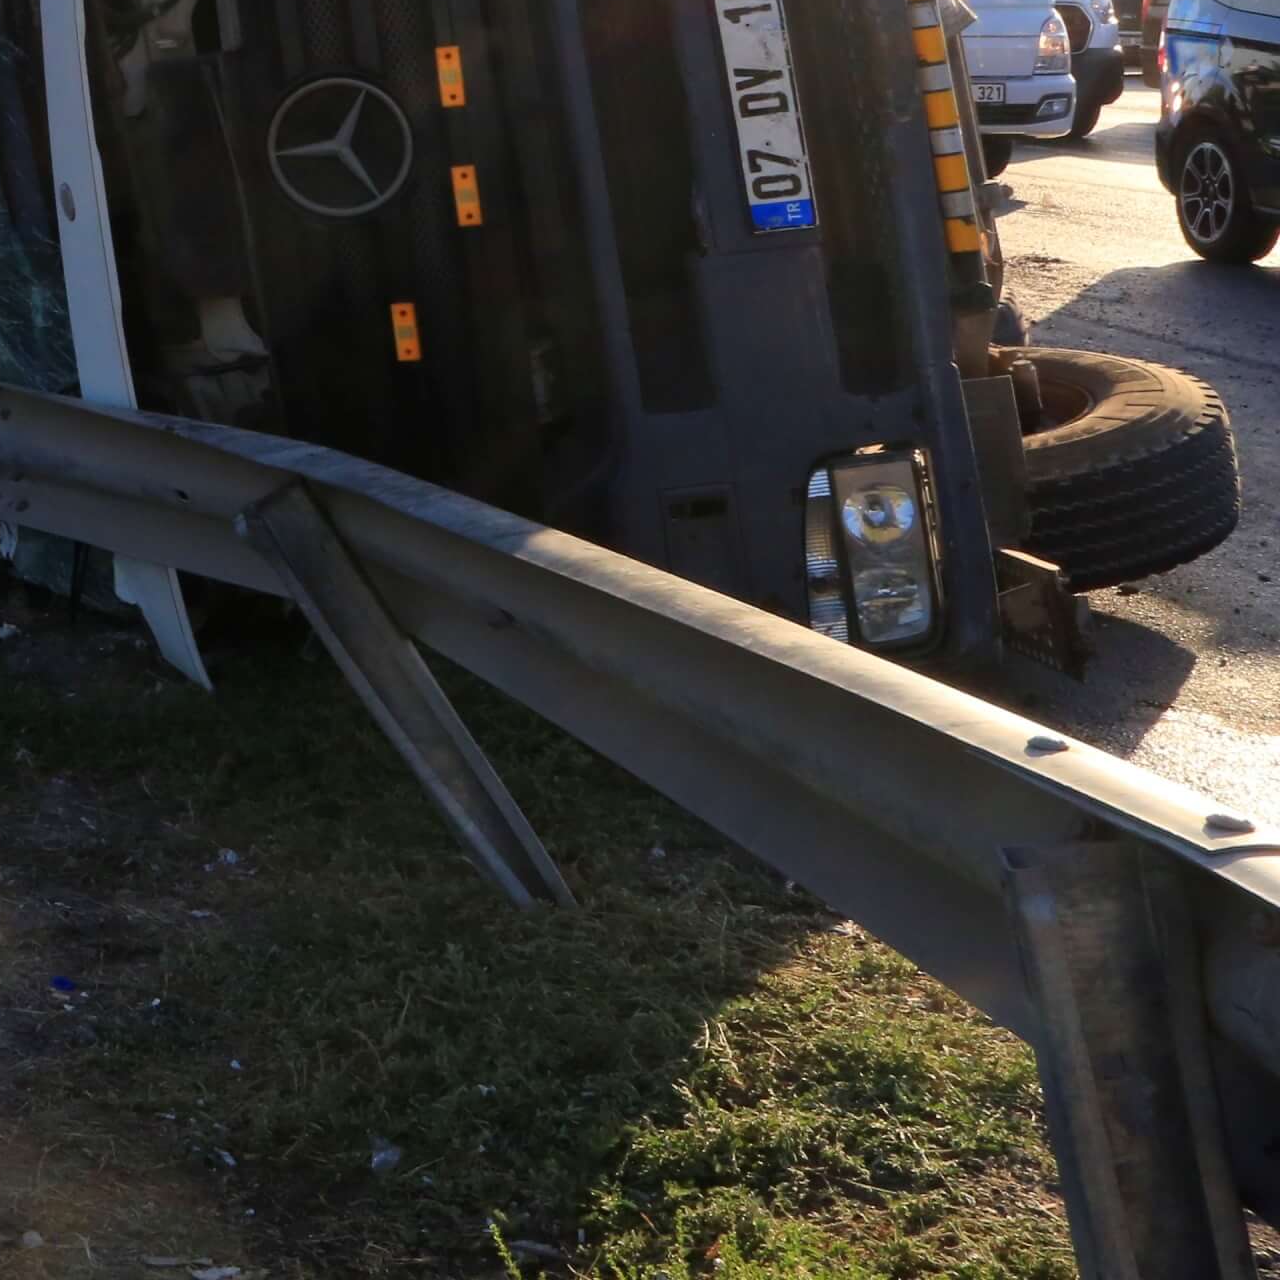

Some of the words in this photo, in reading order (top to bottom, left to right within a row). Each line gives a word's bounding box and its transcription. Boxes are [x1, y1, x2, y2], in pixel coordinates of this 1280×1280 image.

[977, 85, 1002, 101] 321
[747, 149, 802, 200] 07
[786, 202, 802, 222] TR
